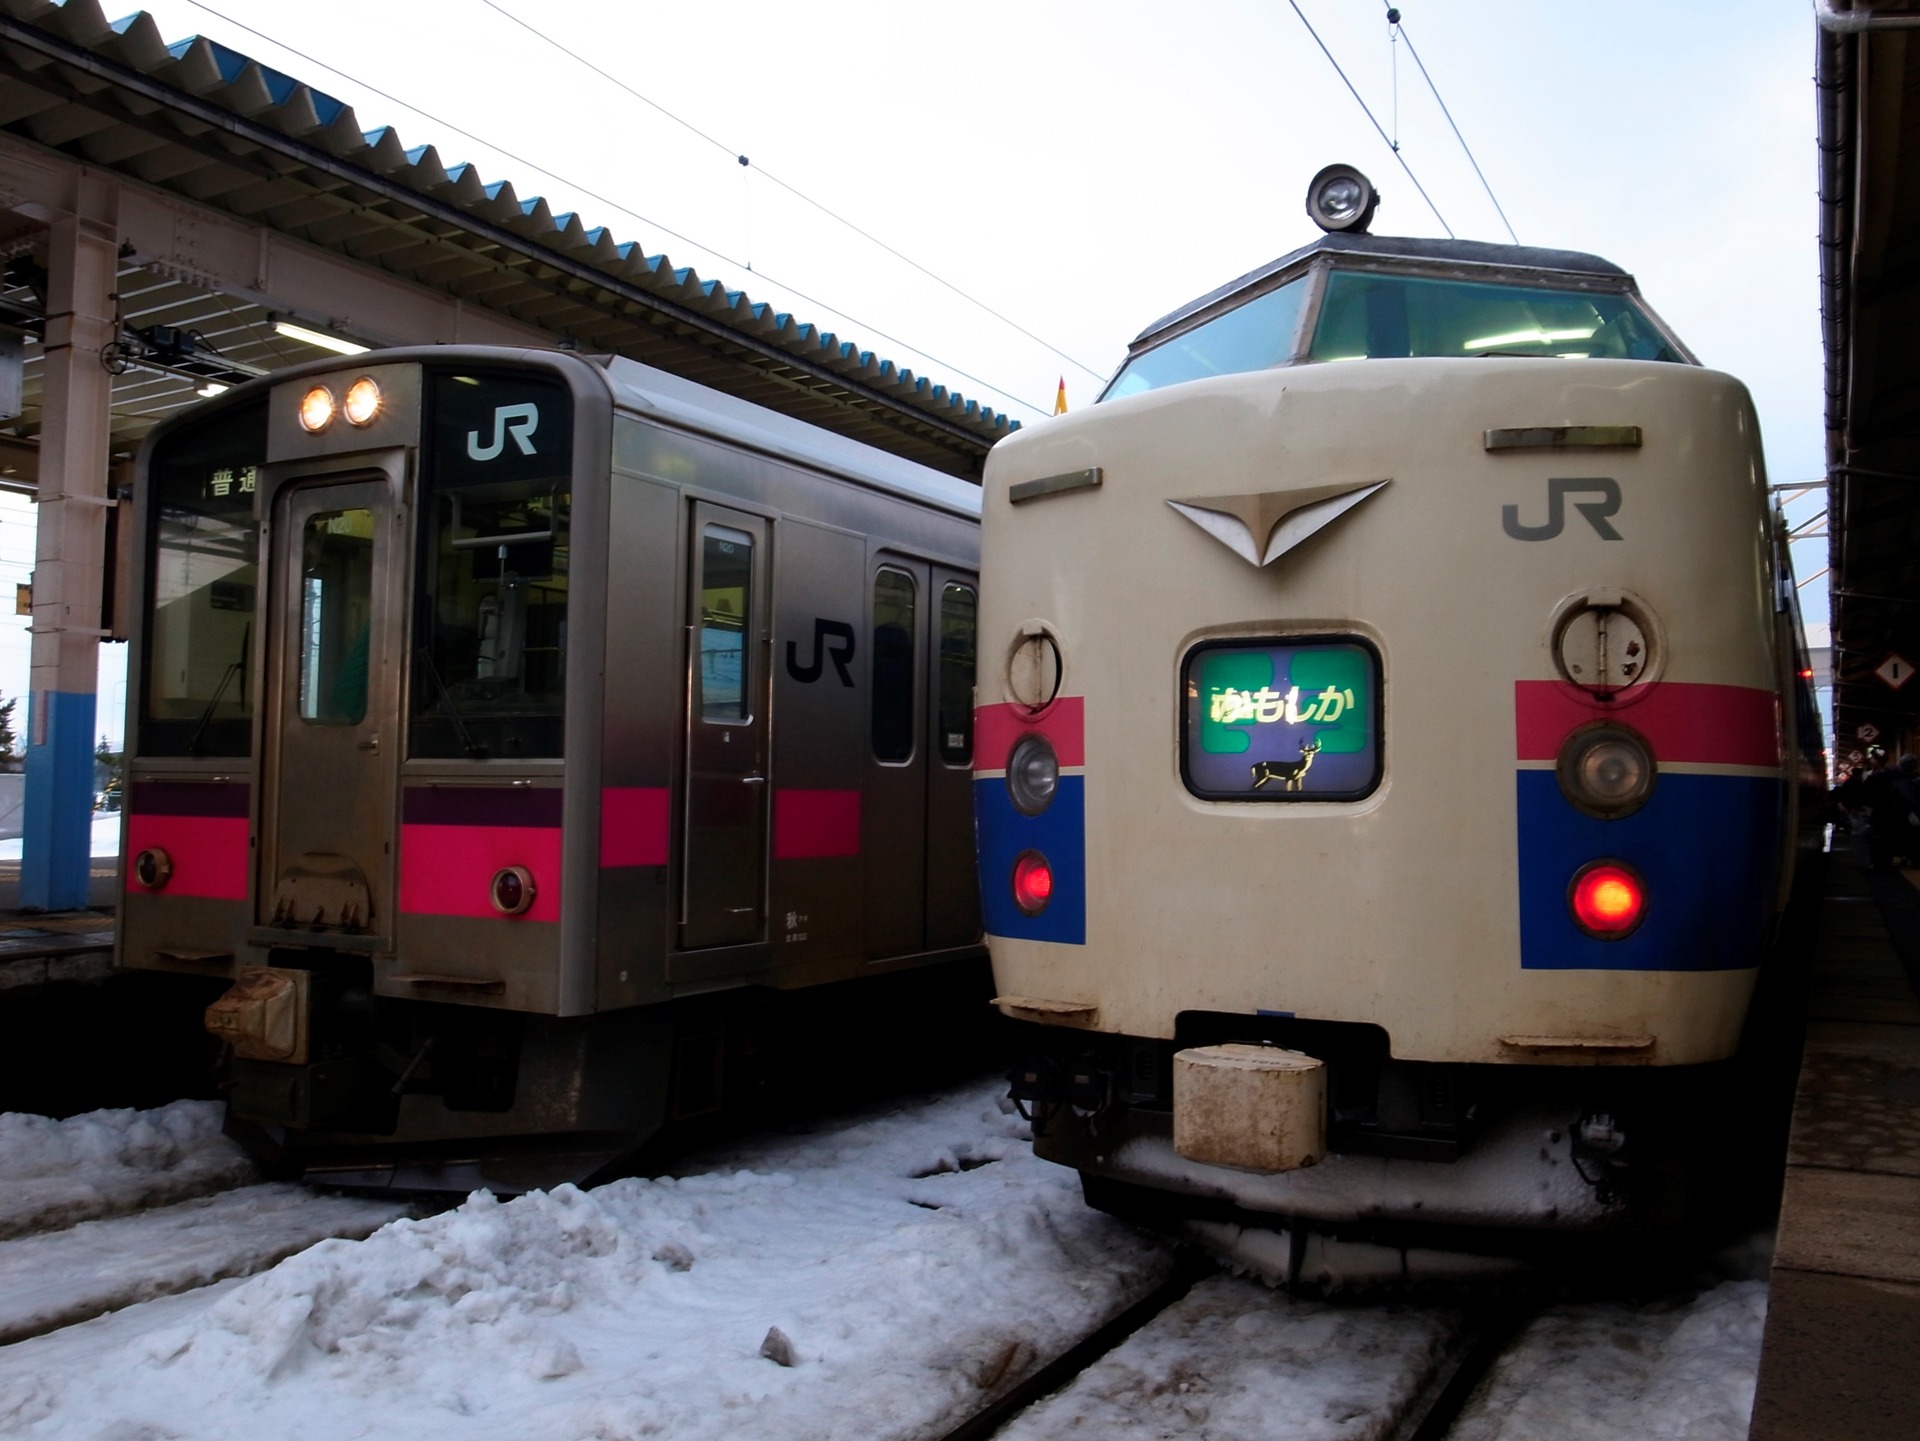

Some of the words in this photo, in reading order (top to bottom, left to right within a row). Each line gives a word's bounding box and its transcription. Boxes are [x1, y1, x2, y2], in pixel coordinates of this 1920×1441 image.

[467, 402, 539, 461] JR
[210, 465, 257, 496] 普通
[1502, 477, 1625, 542] JR
[786, 617, 856, 688] JR
[1863, 727, 1874, 738] 2
